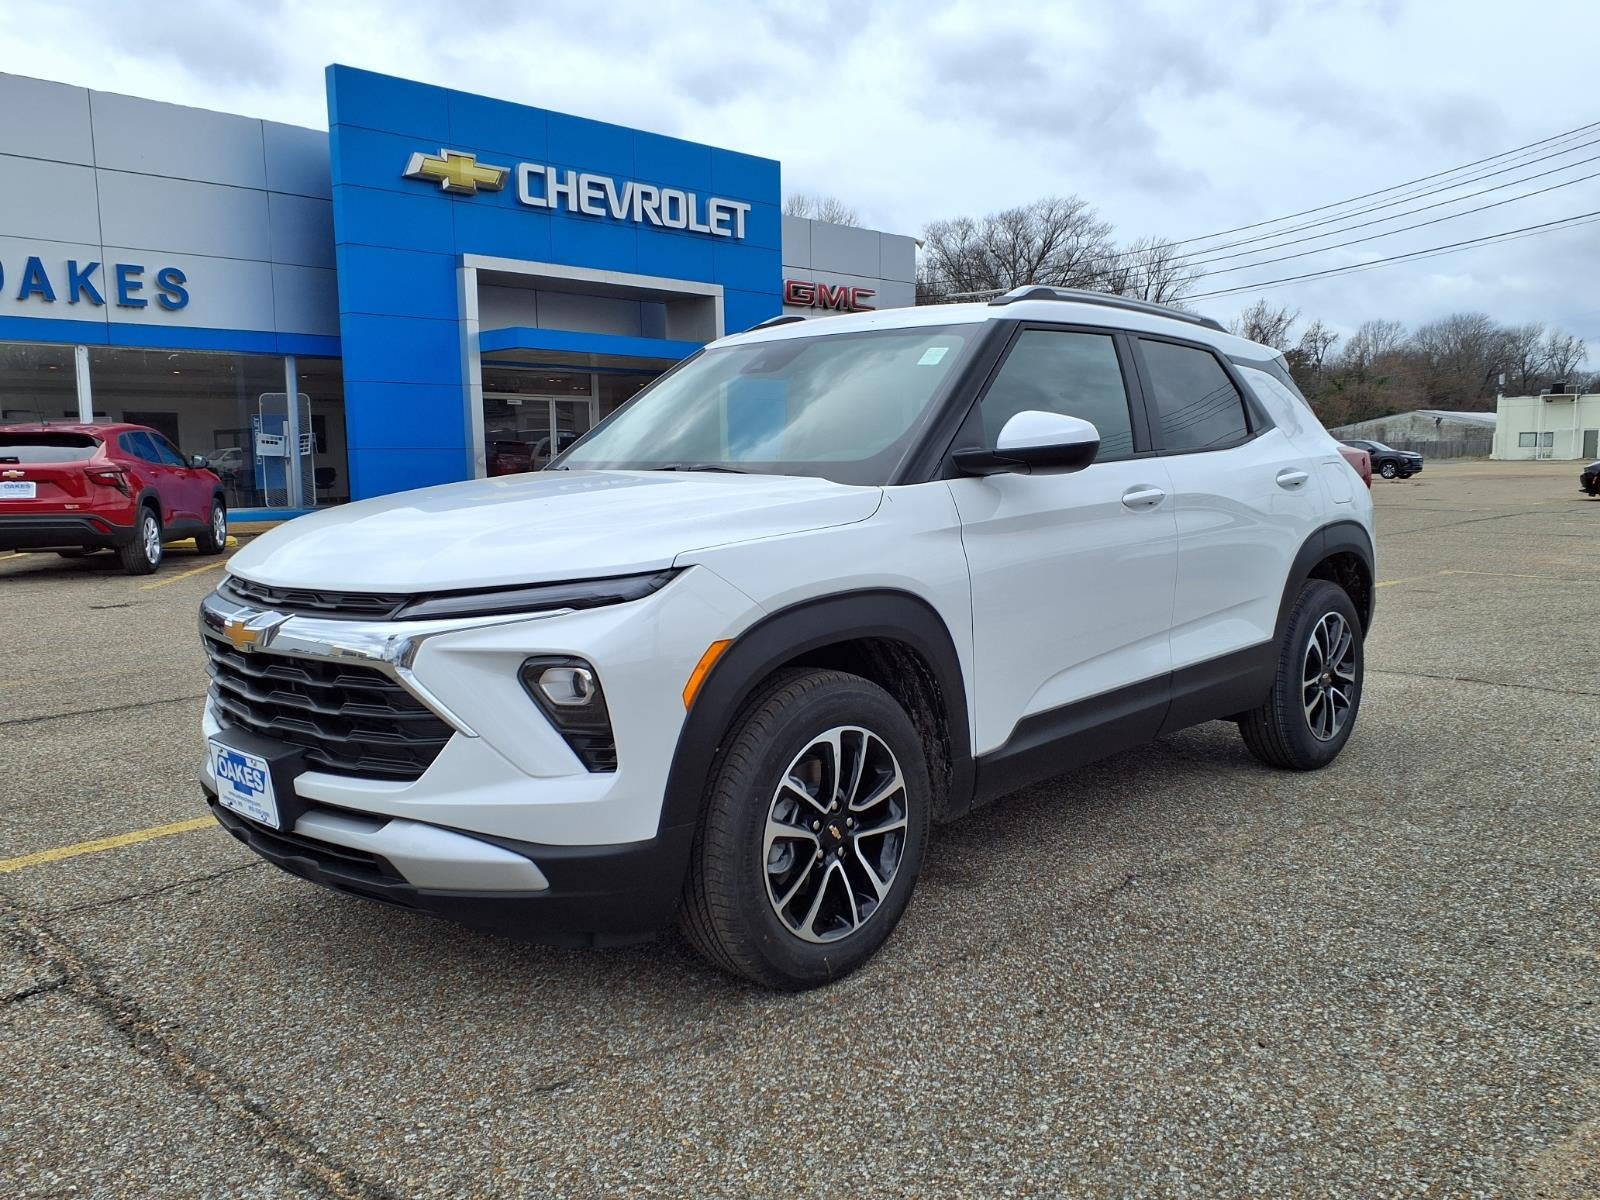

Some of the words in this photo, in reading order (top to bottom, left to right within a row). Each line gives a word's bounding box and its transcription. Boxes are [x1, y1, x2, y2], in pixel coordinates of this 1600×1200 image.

[515, 161, 751, 240] CHEVROLET
[0, 256, 190, 311] AKES
[784, 279, 877, 313] GMC
[219, 755, 264, 792] OAKES
